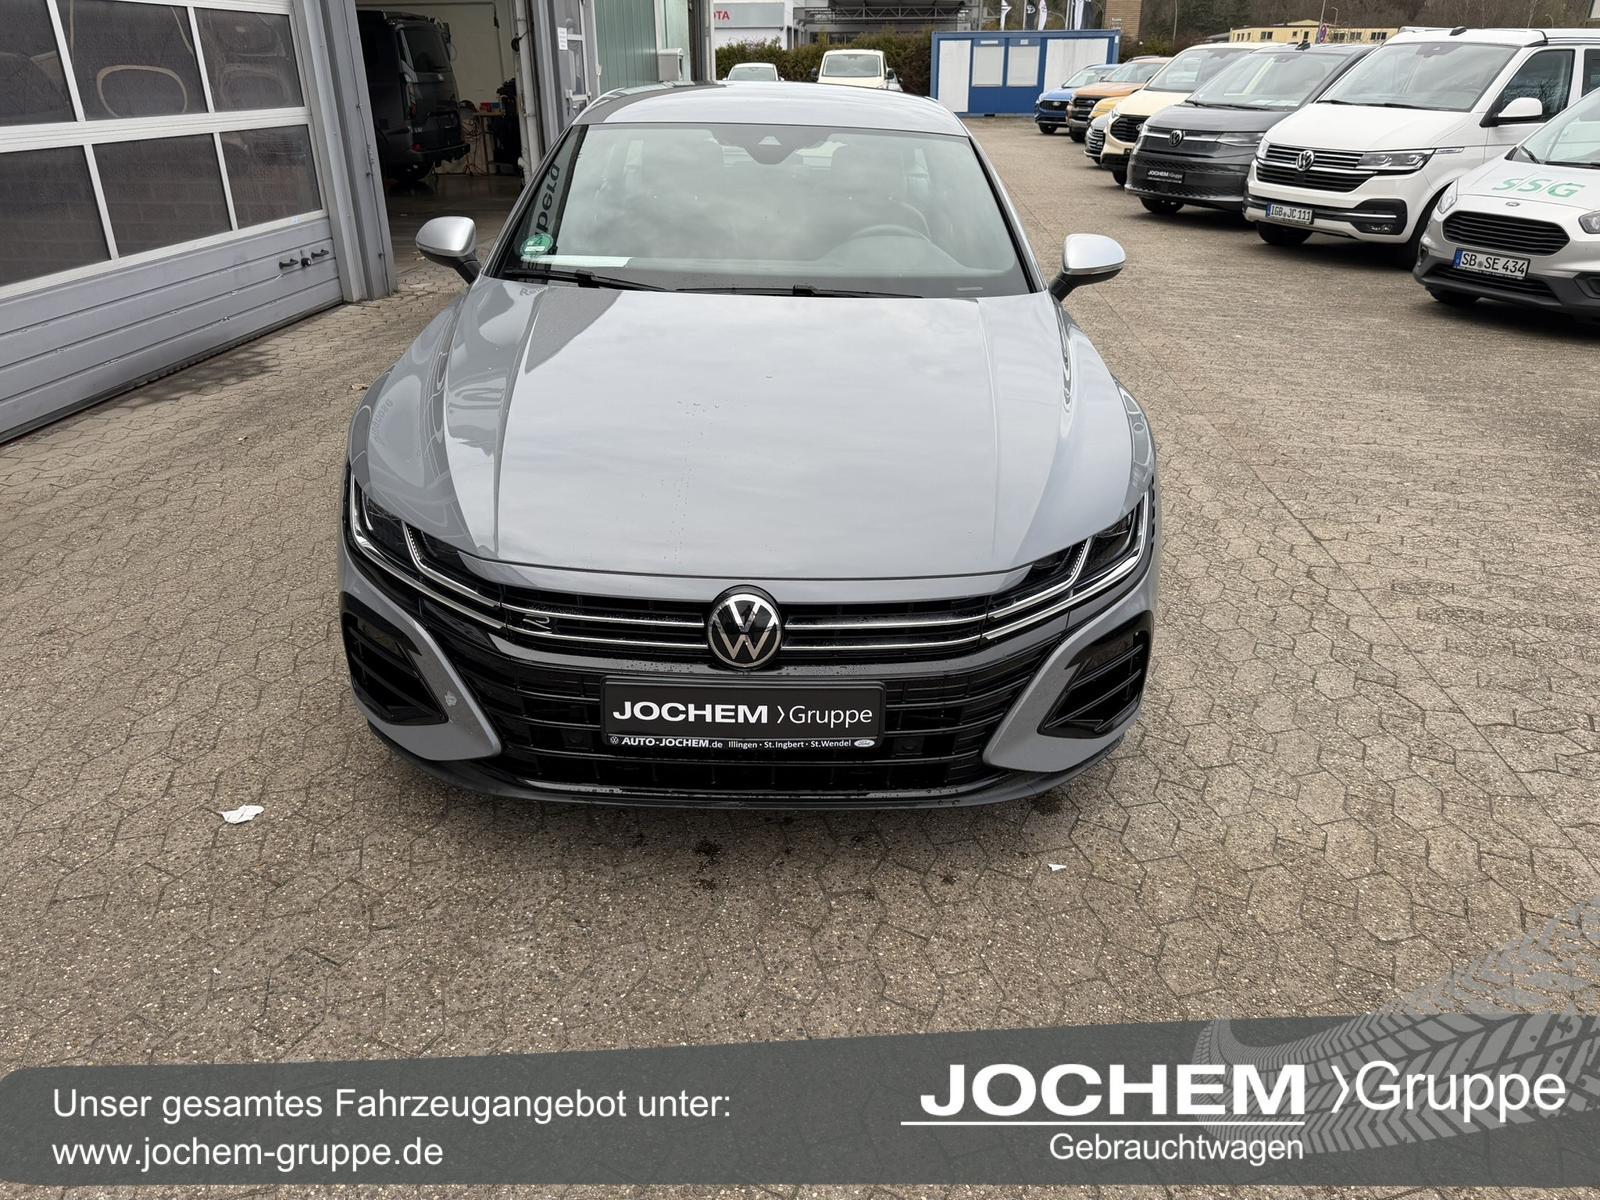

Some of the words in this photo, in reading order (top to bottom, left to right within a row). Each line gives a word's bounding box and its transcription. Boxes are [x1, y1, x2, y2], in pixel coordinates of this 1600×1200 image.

[713, 11, 730, 20] TA
[1492, 177, 1586, 199] SSG
[1271, 205, 1283, 217] IGB
[1287, 208, 1297, 219] JC
[1298, 210, 1311, 221] 111
[1461, 252, 1477, 267] SB
[1484, 256, 1500, 271] SE
[1502, 259, 1526, 275] 434
[612, 701, 768, 724] JOCHEM
[789, 705, 873, 729] Gruppe
[621, 735, 724, 749] AUTO-JOCHEM.de
[728, 738, 758, 749] Illingen
[764, 739, 804, 750] St.Ingbert
[810, 738, 852, 749] St.Wendel
